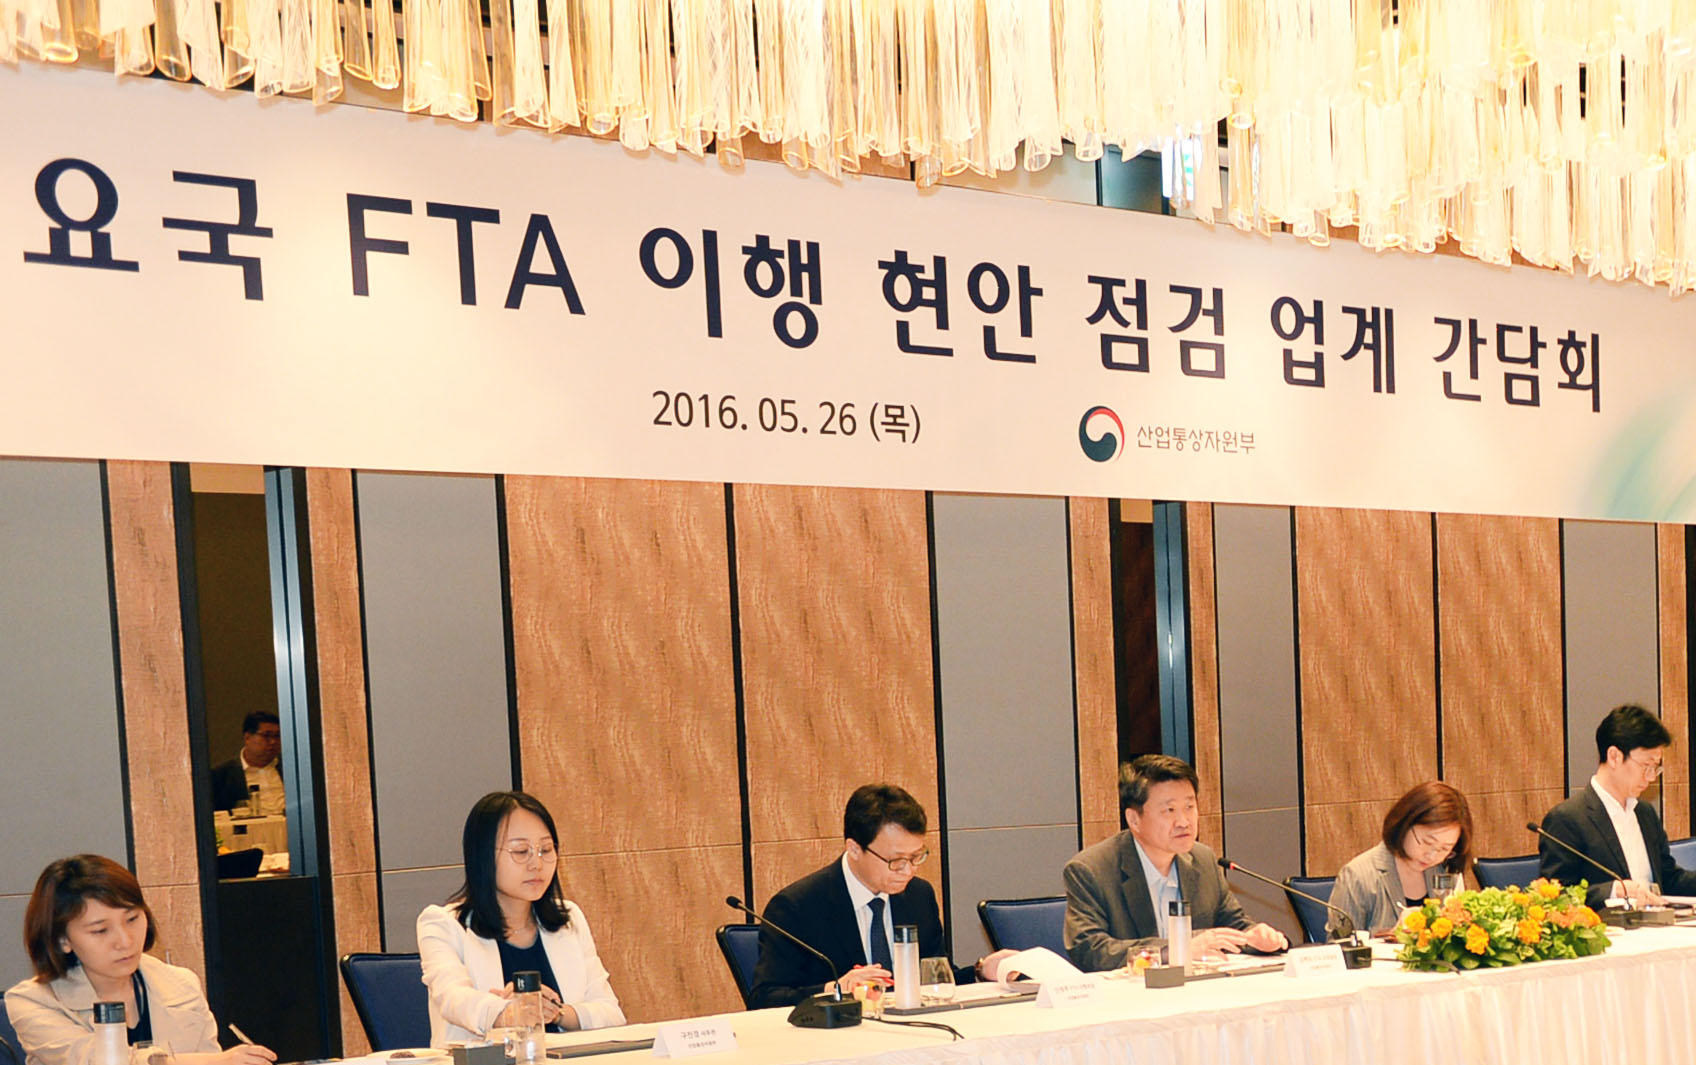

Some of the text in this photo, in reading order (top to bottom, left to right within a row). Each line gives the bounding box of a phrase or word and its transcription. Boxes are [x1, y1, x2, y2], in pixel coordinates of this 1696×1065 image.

[23, 157, 1601, 413] 요국 FTA 이행 현안 점검 업계 간담회
[652, 390, 921, 444] 2016. 05. 26 (목)
[1137, 425, 1255, 453] 산업통상자원부
